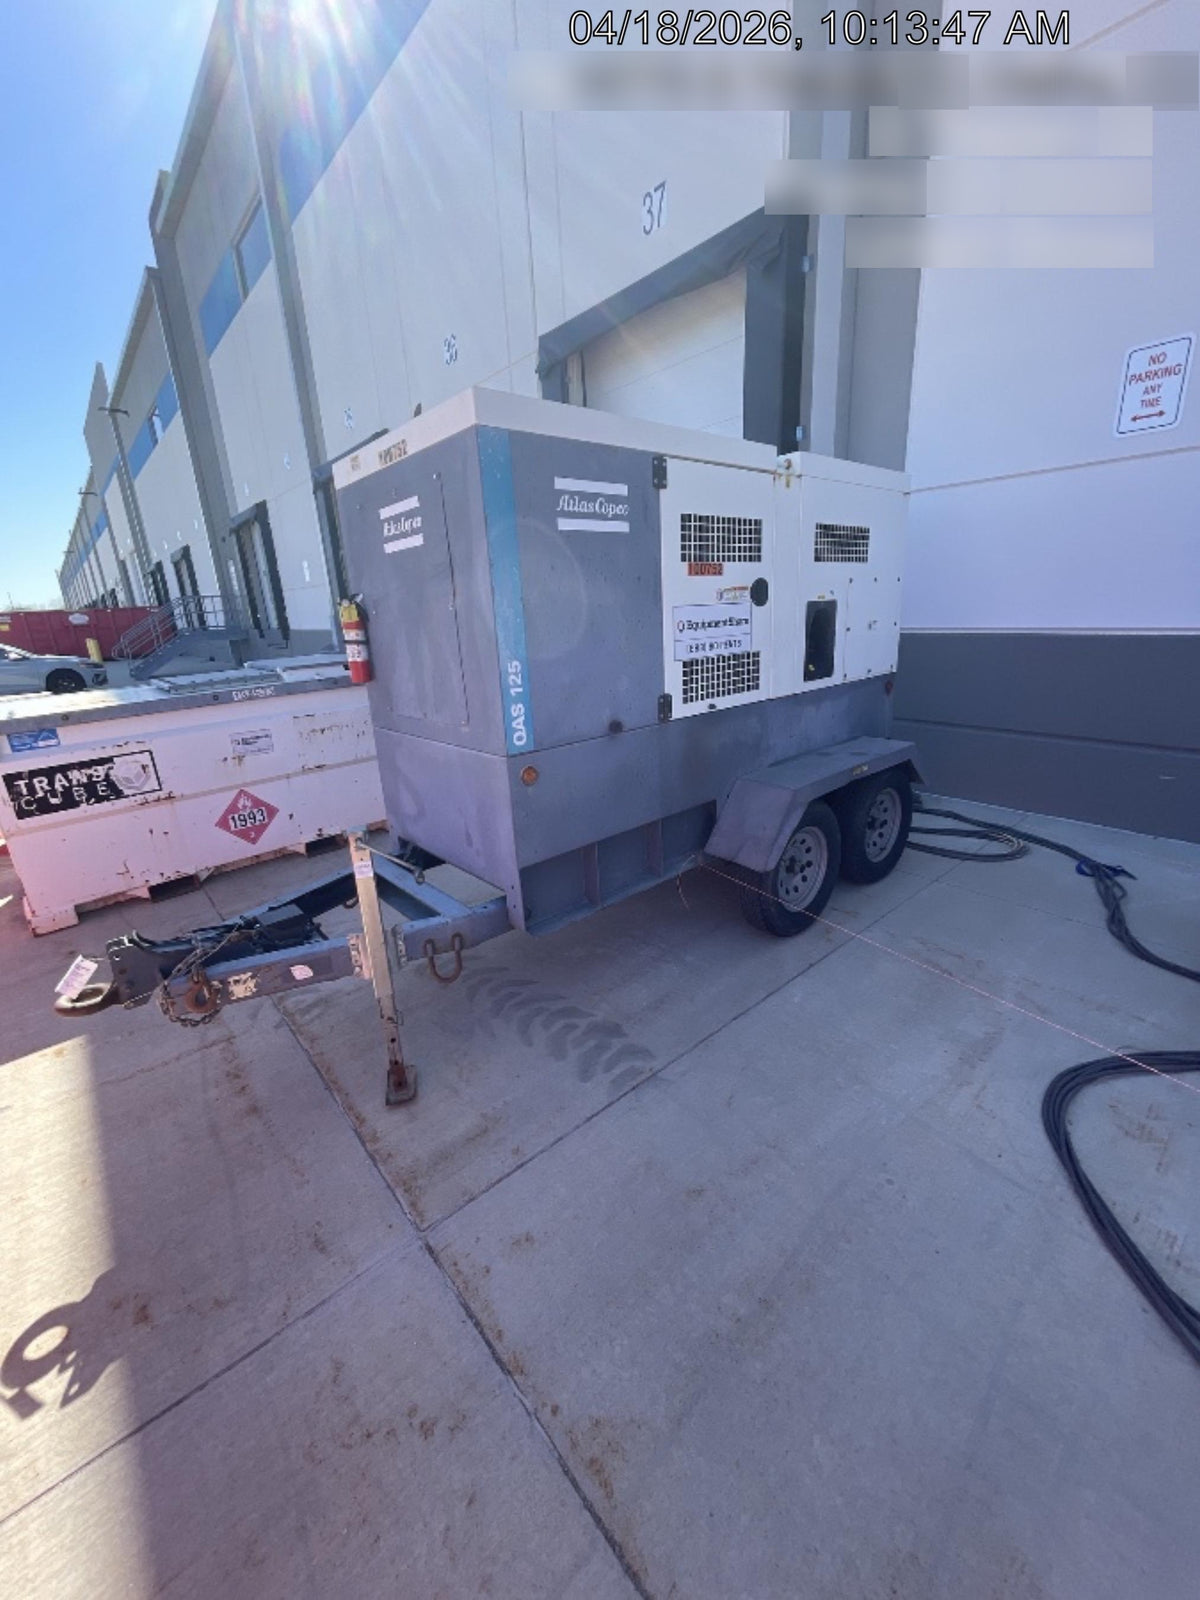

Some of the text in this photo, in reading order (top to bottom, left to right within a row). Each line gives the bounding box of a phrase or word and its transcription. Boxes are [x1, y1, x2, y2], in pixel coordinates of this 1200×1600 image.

[642, 179, 667, 236] 37
[1148, 352, 1167, 366] NO
[1128, 363, 1182, 386] PARKING
[1142, 383, 1162, 395] ANY
[1141, 396, 1161, 408] TIME
[507, 660, 528, 746] QAS 125
[230, 808, 267, 829] 1993
